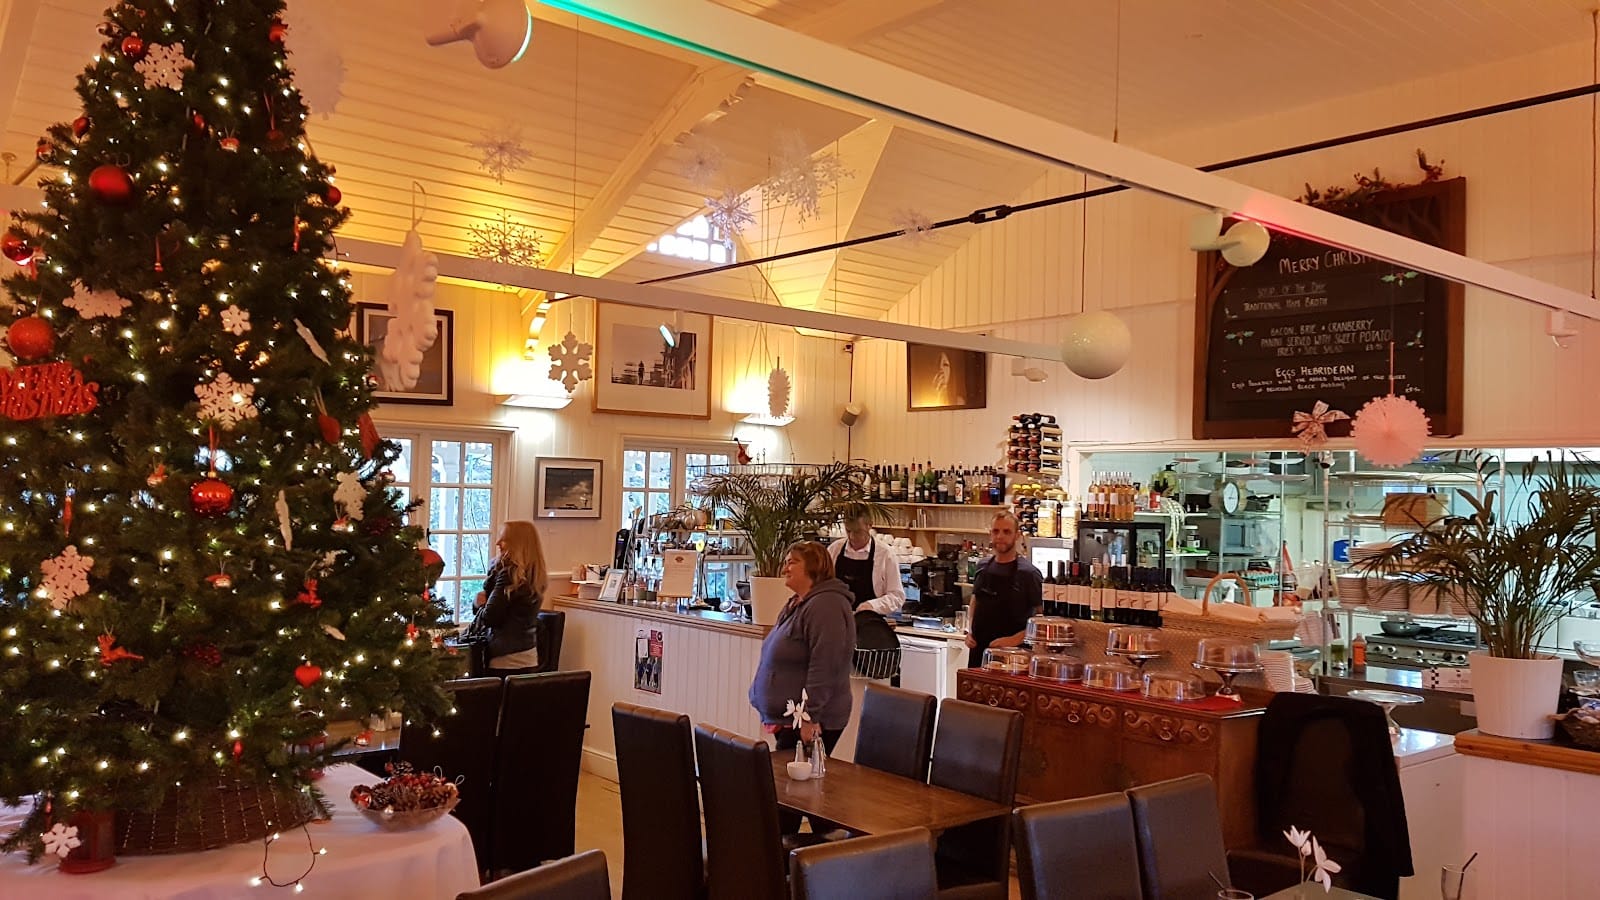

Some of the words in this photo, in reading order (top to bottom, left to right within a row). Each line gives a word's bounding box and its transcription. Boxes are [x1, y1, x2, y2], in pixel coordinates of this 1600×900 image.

[1279, 256, 1319, 274] MERRY
[1328, 319, 1375, 333] CRANBERRY
[1287, 335, 1311, 347] SERVED
[1314, 334, 1332, 345] WITH
[1335, 332, 1356, 344] SWEET
[1360, 329, 1392, 343] POTATO
[1300, 364, 1355, 376] HEBRIDEAN
